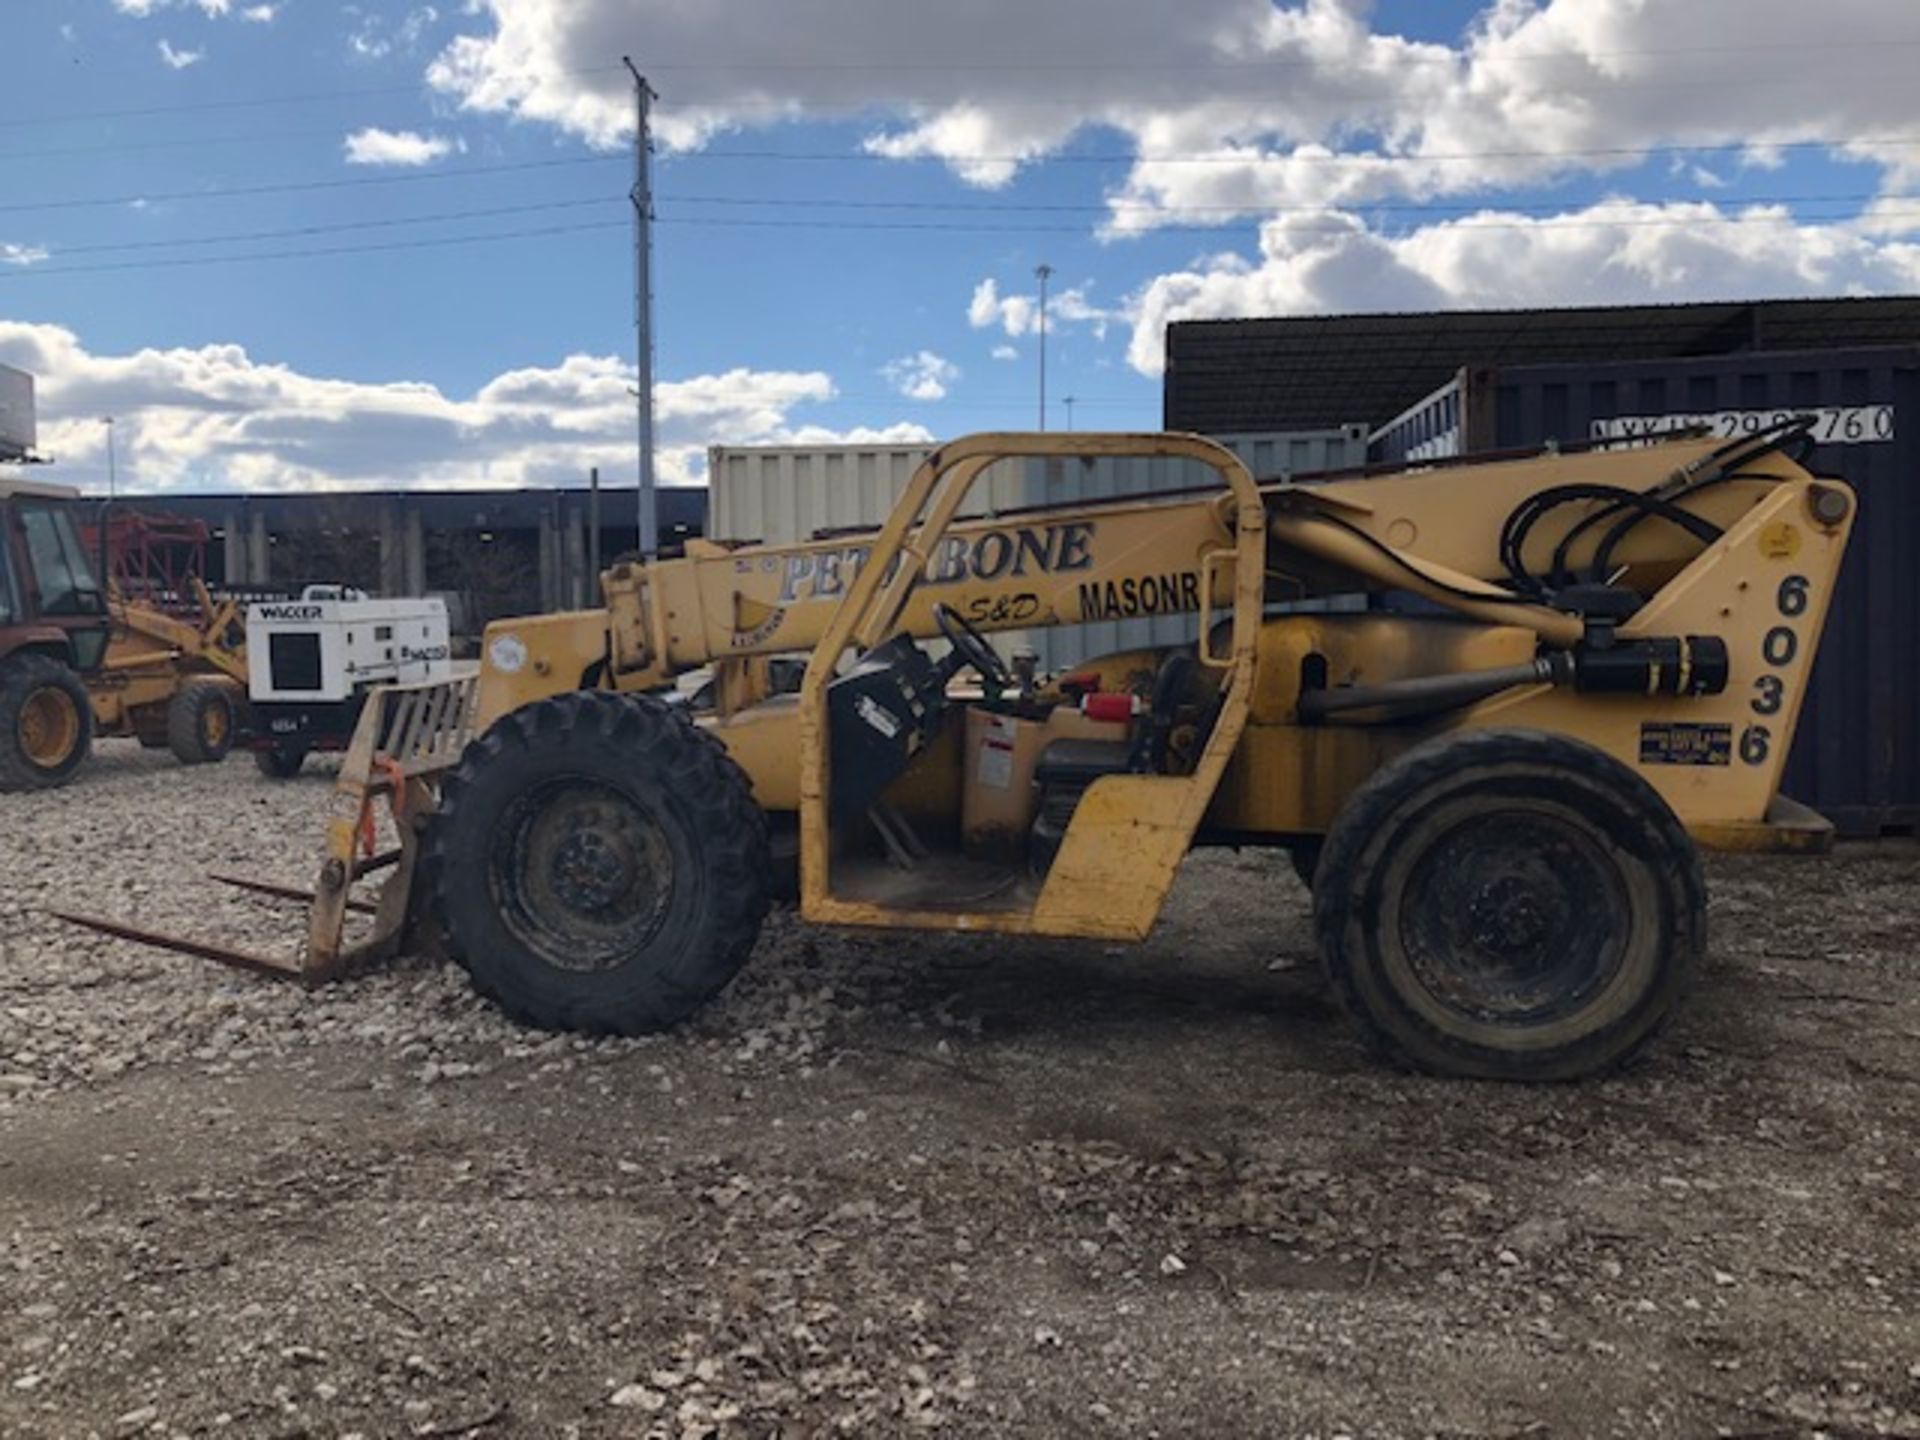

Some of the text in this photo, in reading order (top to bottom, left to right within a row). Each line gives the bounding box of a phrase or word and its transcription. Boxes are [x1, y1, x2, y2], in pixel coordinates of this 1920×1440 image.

[1720, 406, 1893, 439] 29760
[778, 522, 1096, 604] PETBONE
[1739, 575, 1810, 765] 6036
